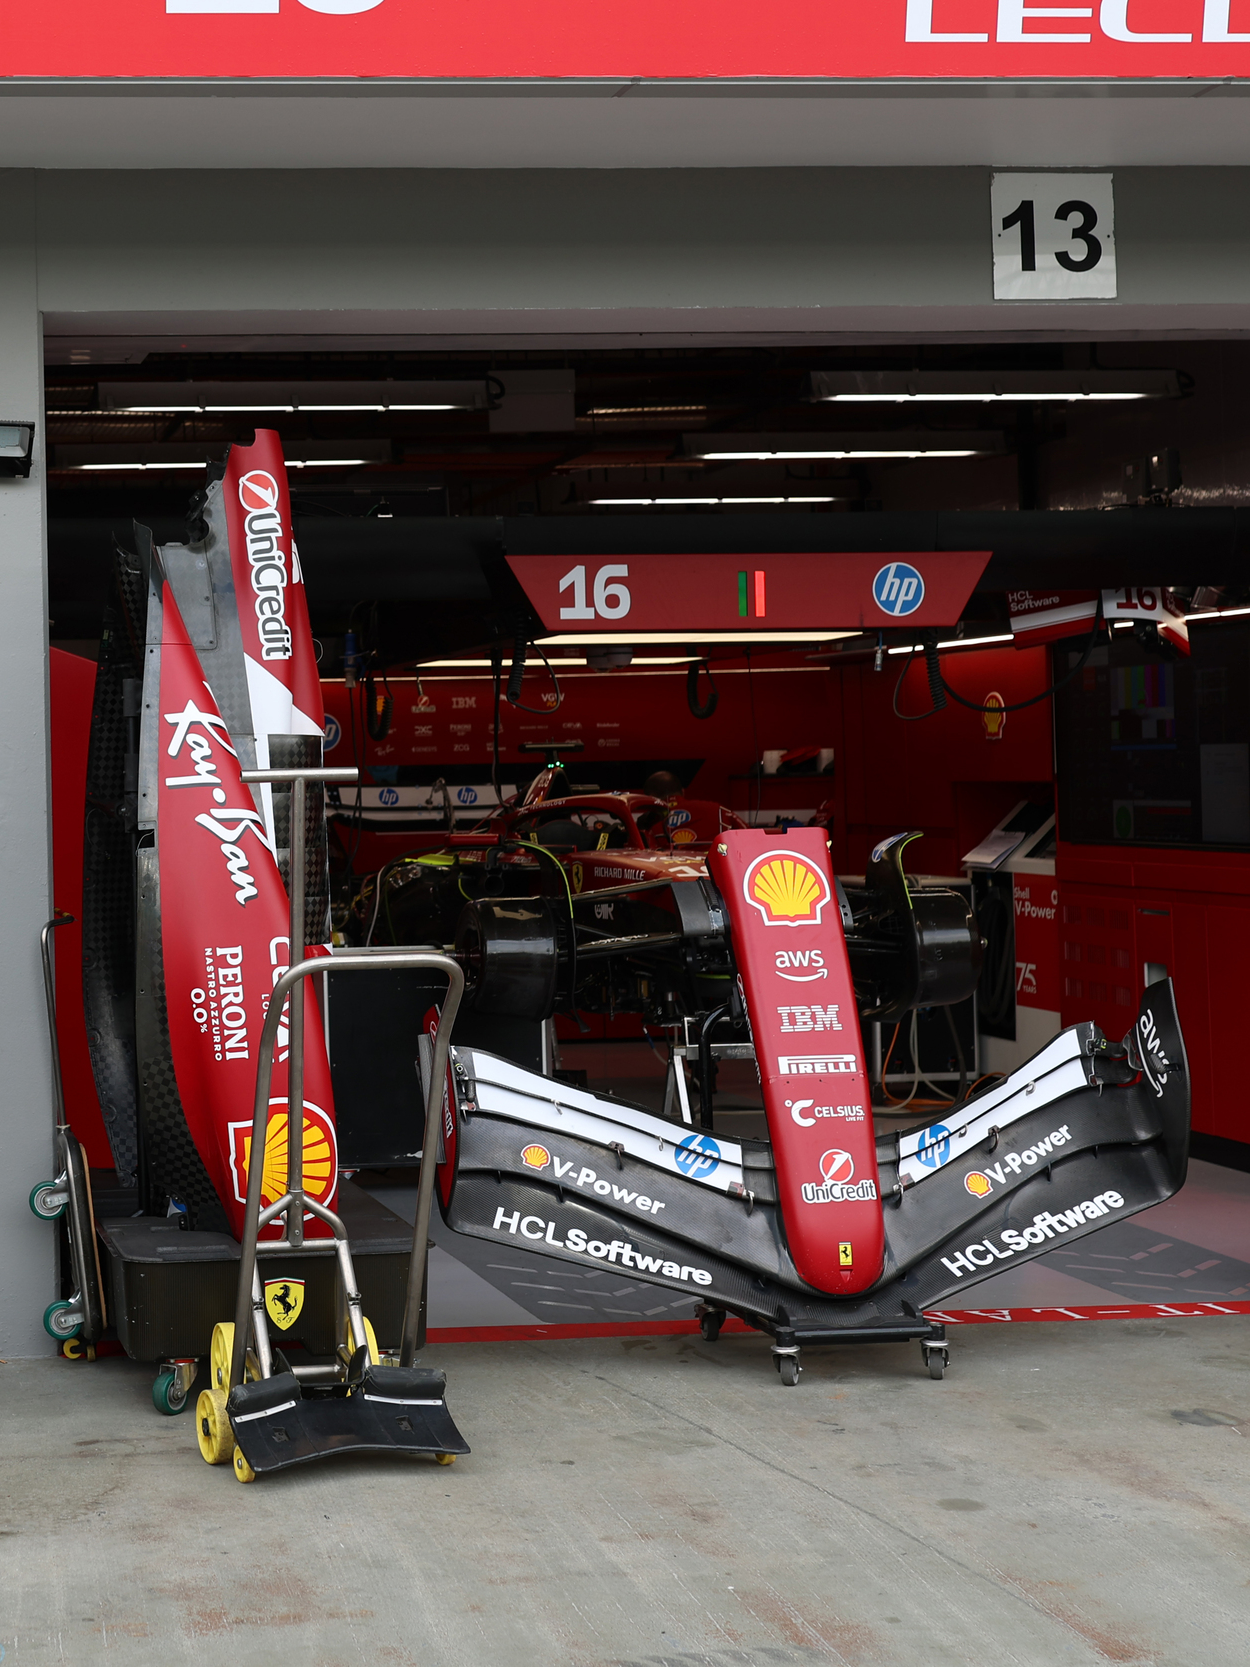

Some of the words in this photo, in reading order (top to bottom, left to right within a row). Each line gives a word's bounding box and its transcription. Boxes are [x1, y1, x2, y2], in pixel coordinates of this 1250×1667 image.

[1001, 200, 1103, 273] 13
[244, 509, 293, 661] UniCredit
[558, 564, 632, 620] 16
[877, 562, 920, 616] hp
[1008, 590, 1033, 602] HCL
[1114, 587, 1158, 611] 16
[1009, 593, 1061, 613] Software
[451, 696, 477, 709] IBM
[594, 866, 623, 880] RICHARD
[623, 869, 647, 881] MILLE
[1014, 900, 1057, 920] V-Power
[204, 947, 217, 998] NASTRO
[774, 949, 825, 968] aws
[215, 945, 250, 1060] PERONI
[209, 1001, 223, 1061] AZZURRO
[776, 1004, 843, 1033] IBM
[777, 1054, 857, 1075] PIRELLI
[813, 1105, 865, 1119] CELSIUS
[919, 1126, 949, 1168] hp
[983, 1124, 1073, 1185] V-Power
[552, 1156, 666, 1215] V-Power
[801, 1179, 878, 1203] UniCredit
